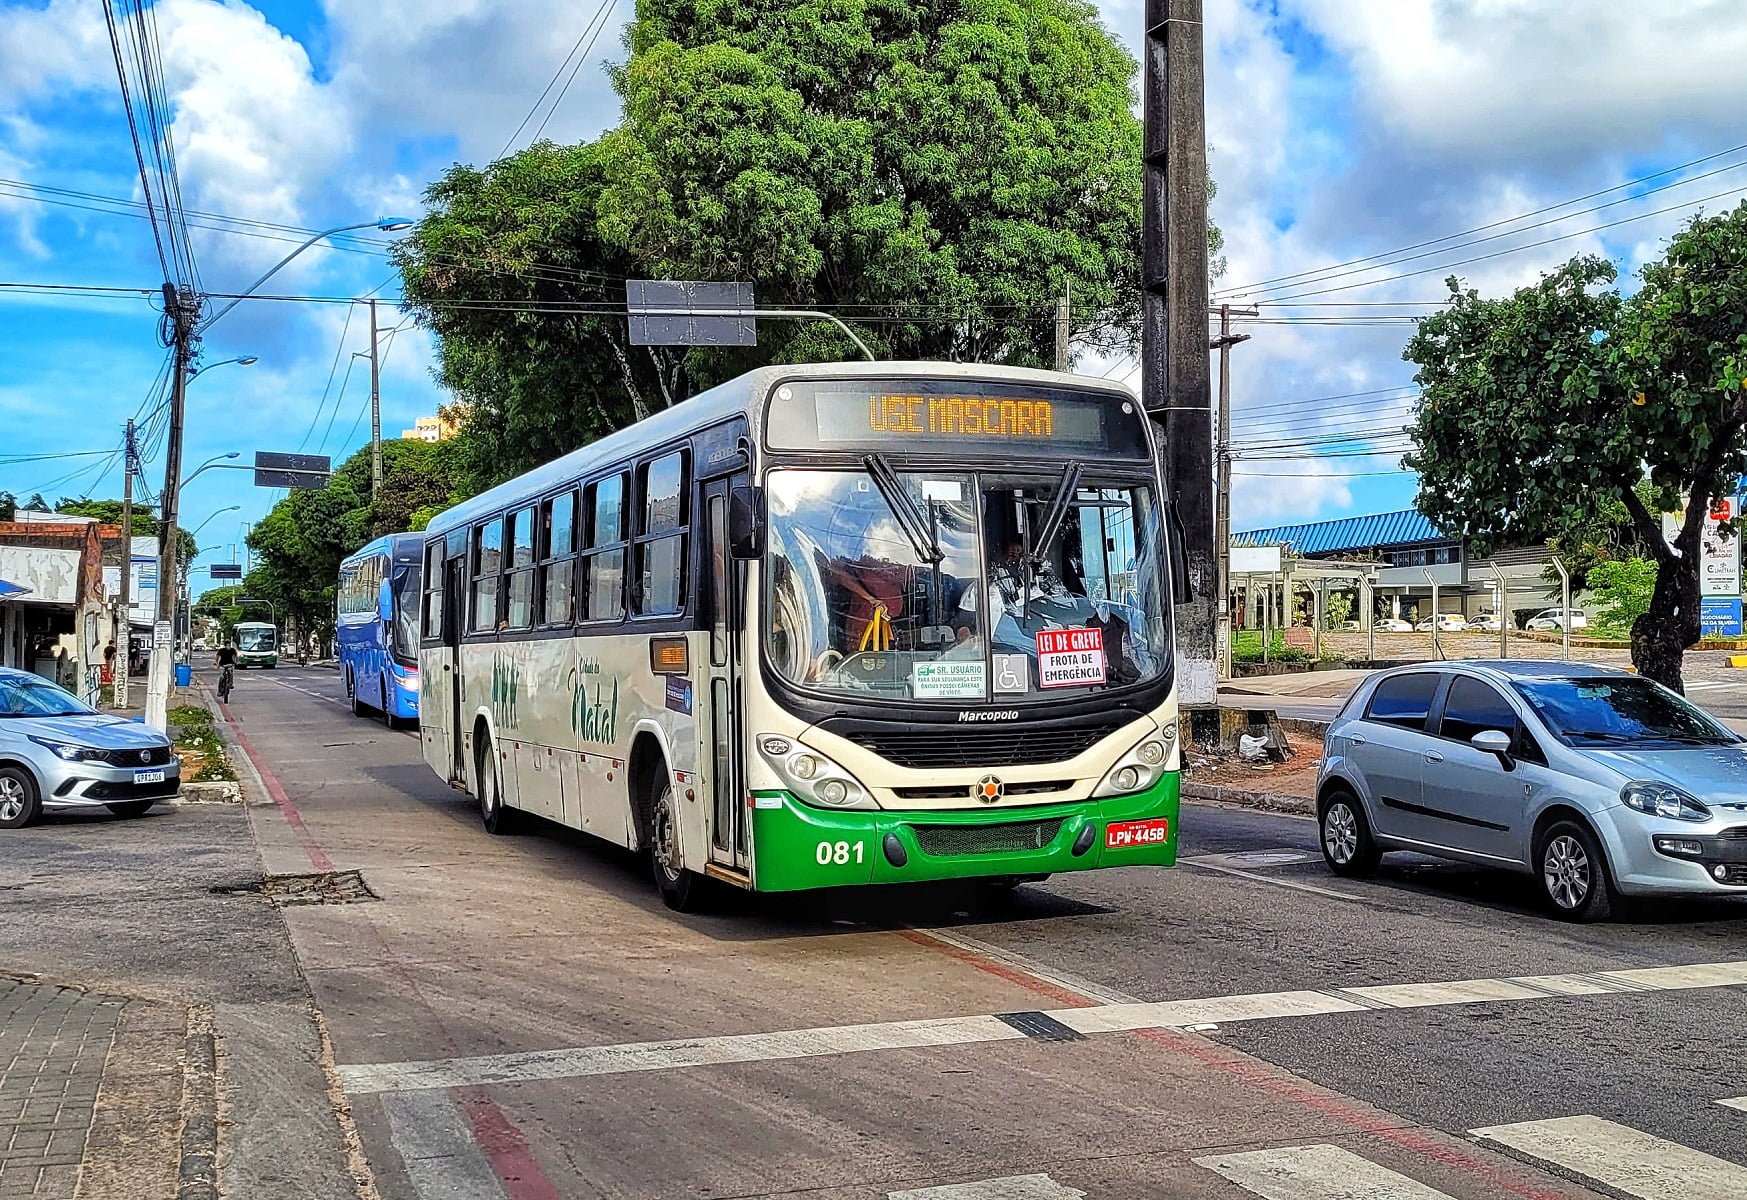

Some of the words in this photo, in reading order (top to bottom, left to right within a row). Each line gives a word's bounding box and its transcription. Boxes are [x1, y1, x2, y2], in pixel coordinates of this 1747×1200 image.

[869, 395, 924, 432] USE
[928, 397, 1052, 436] MASCARA
[1040, 634, 1053, 652] LEI
[1056, 633, 1069, 651] DE
[1071, 631, 1100, 650] GREVE
[1050, 654, 1079, 667] FROTA
[1081, 653, 1093, 664] DE
[950, 664, 982, 674] USUÁRIO
[1045, 665, 1102, 682] EMERGÊNCIA
[958, 710, 1019, 722] Marcopolo
[816, 841, 864, 865] 081
